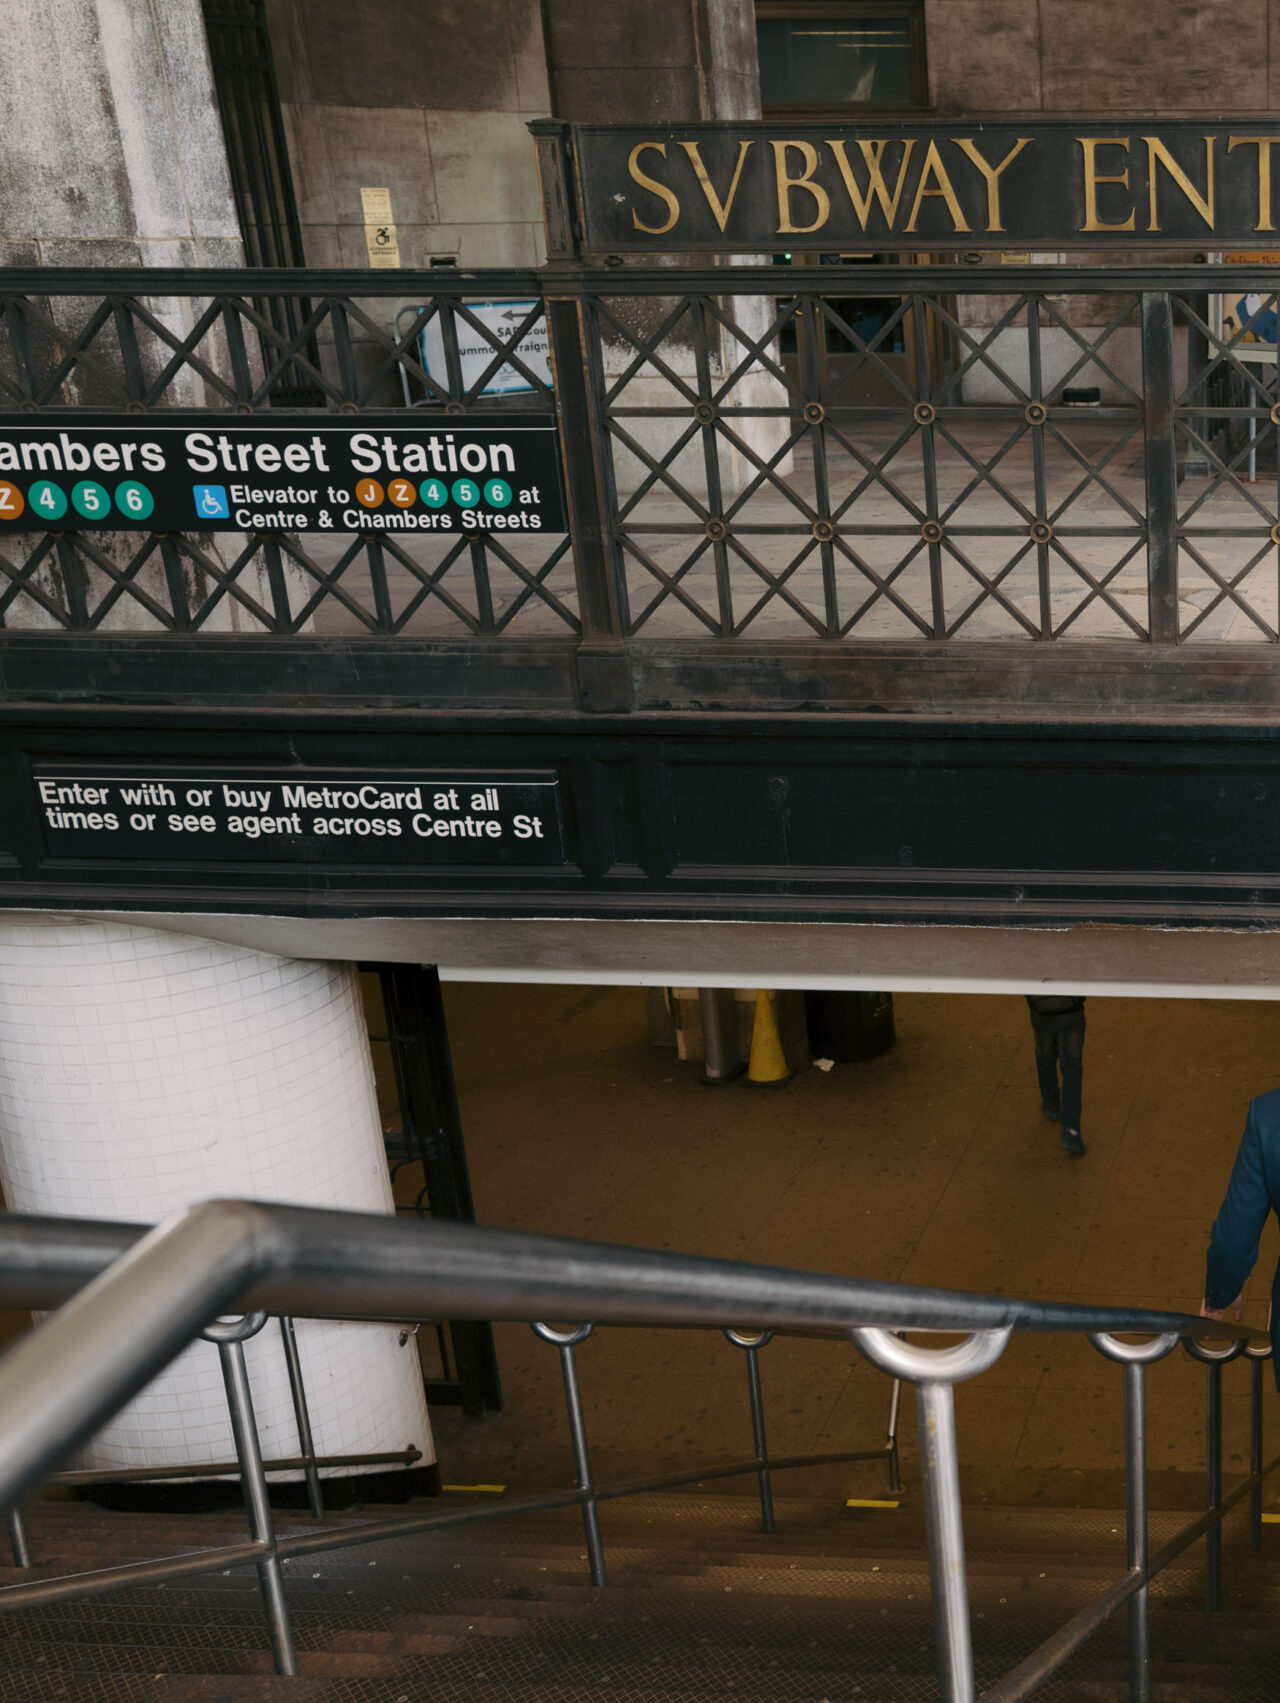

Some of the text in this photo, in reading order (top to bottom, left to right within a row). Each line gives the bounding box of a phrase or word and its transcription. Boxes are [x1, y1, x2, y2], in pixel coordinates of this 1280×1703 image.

[628, 137, 1036, 235] SVBWAY
[186, 433, 330, 473] Street
[350, 434, 516, 473] Station
[0, 487, 143, 511] Z 4 5 6
[231, 485, 541, 504] Elevator to J Z 4 5 6 at
[236, 509, 542, 529] Centre & Chambers Streets
[38, 781, 500, 812] Enter with or buy MetroCard at all
[46, 806, 544, 839] times or see agent across Centre St
